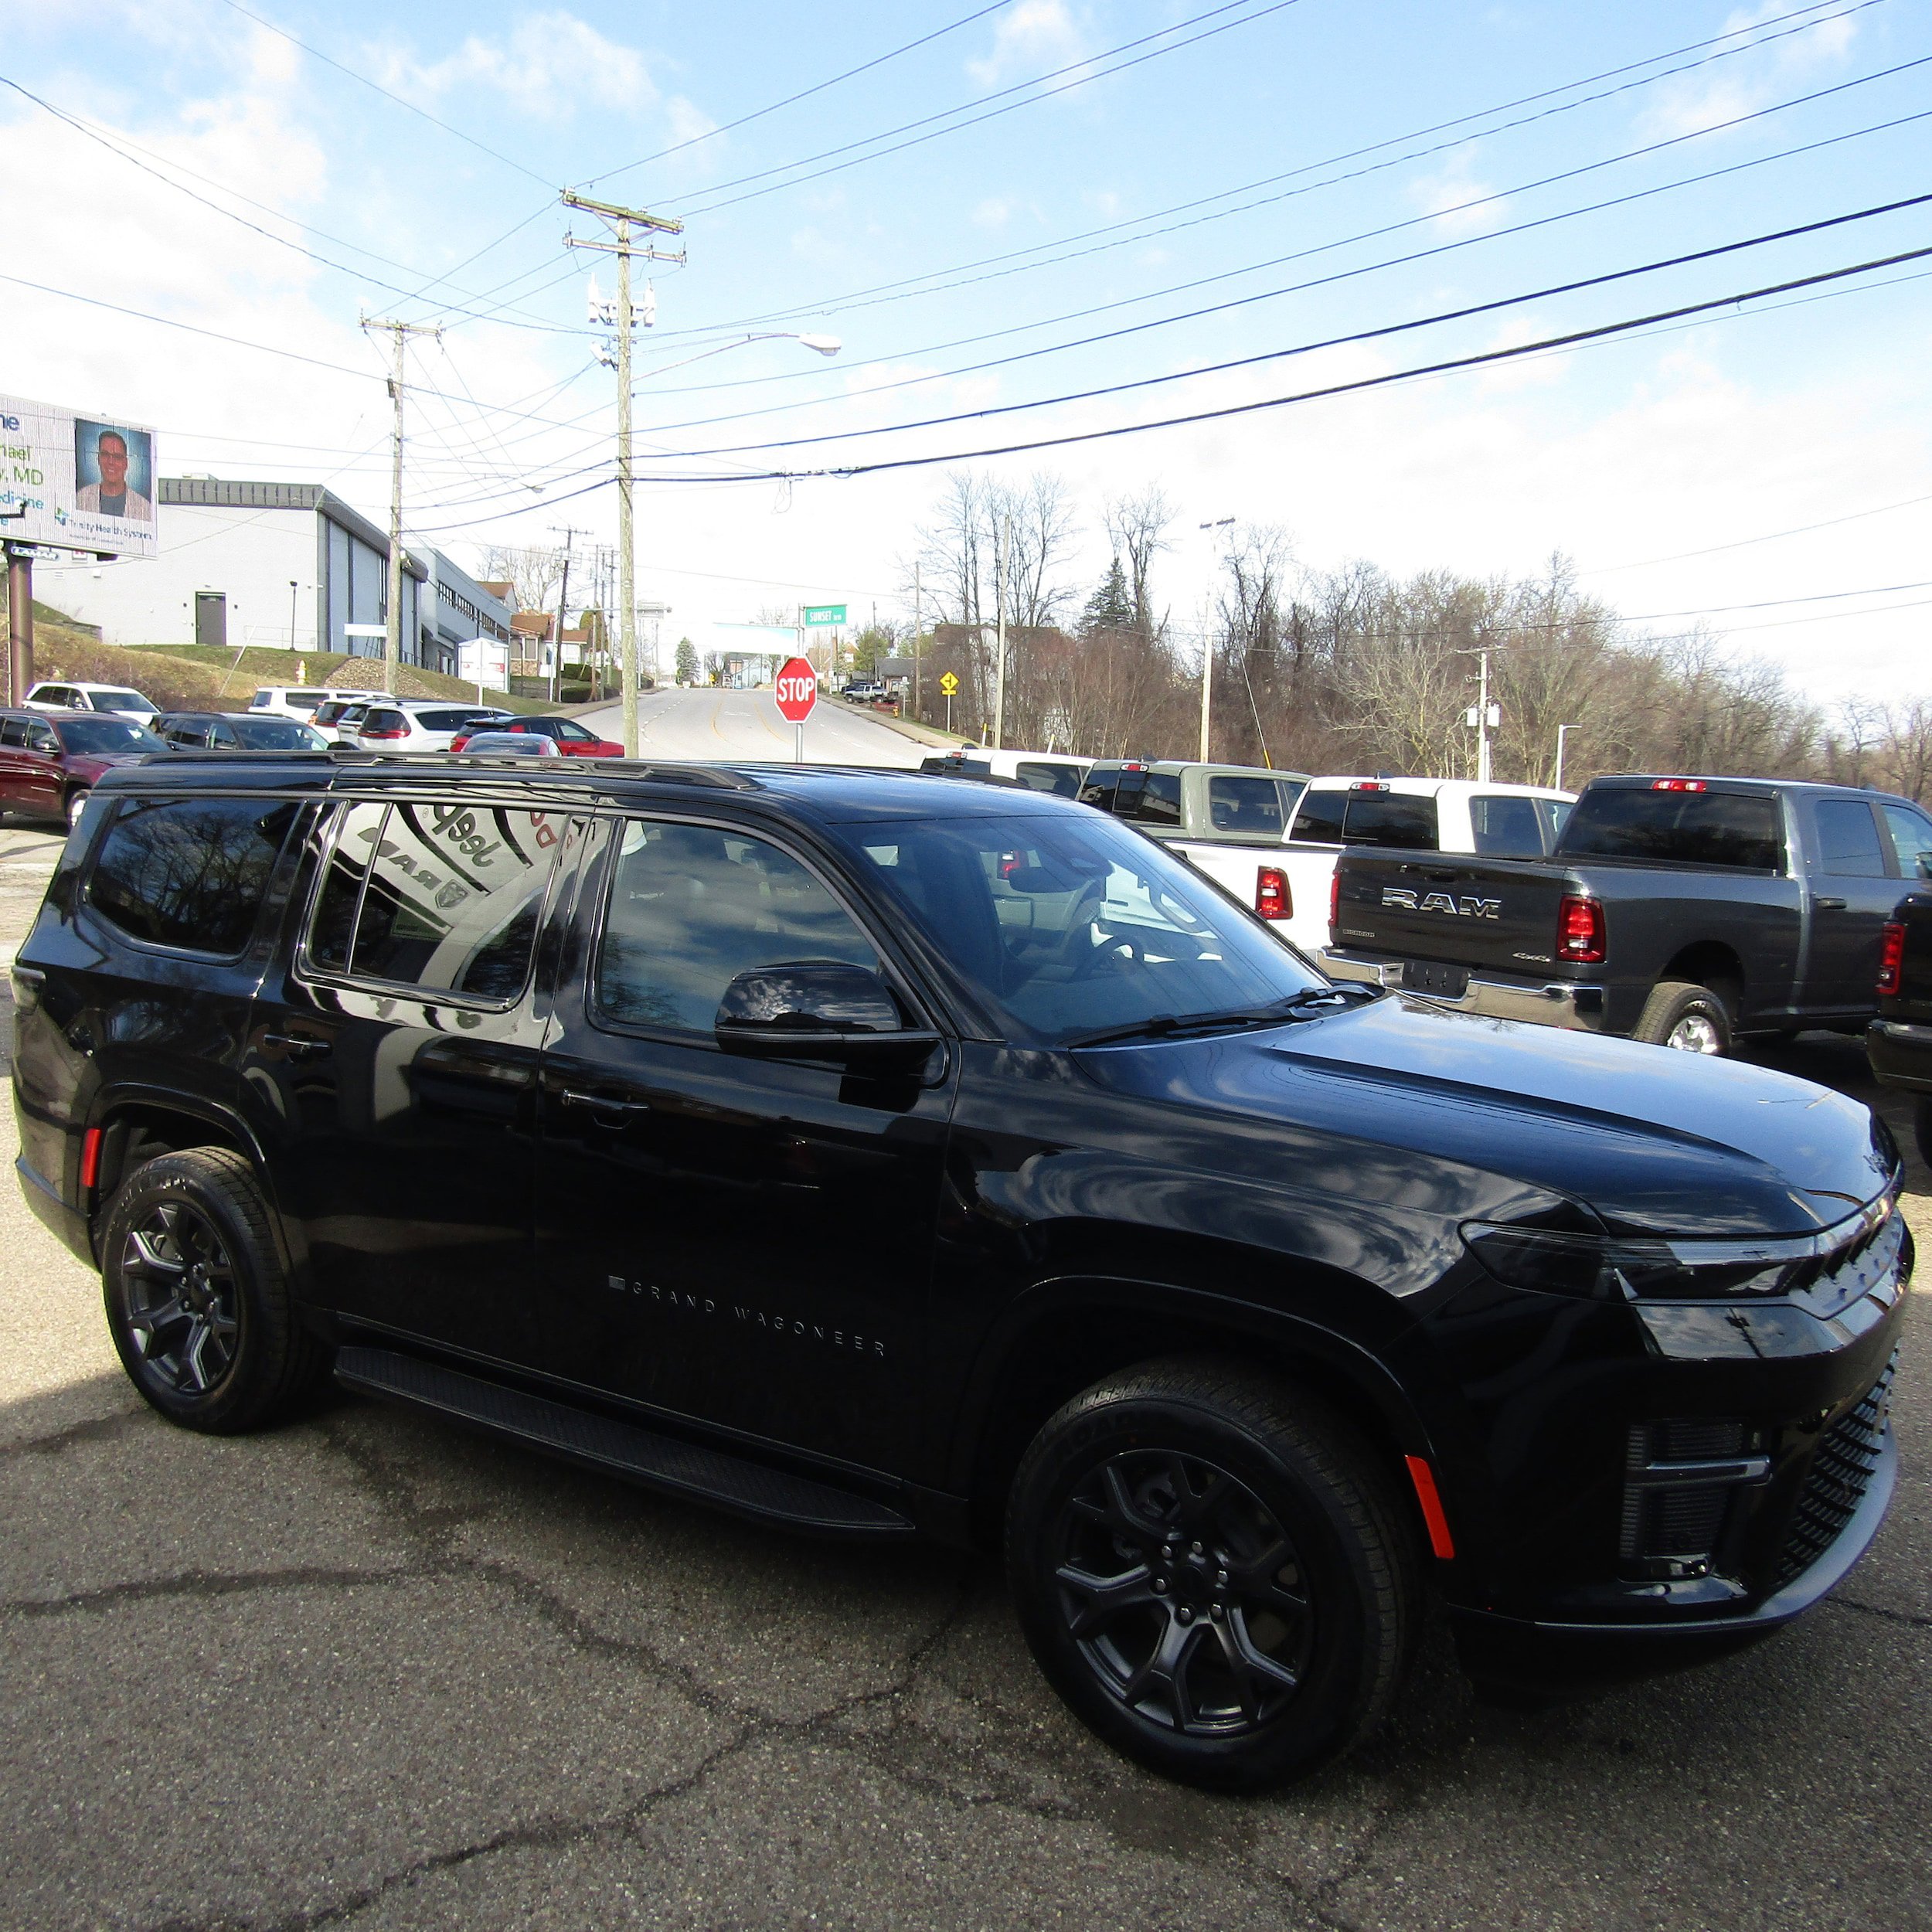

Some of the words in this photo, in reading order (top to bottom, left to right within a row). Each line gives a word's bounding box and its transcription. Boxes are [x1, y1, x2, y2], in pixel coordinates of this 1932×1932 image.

[14, 465, 44, 485] MD
[809, 610, 832, 623] SUNSET
[777, 677, 815, 702] STOP
[1381, 887, 1502, 920] RAM
[632, 1281, 716, 1313] GRAND
[734, 1305, 885, 1357] WAGONEER
